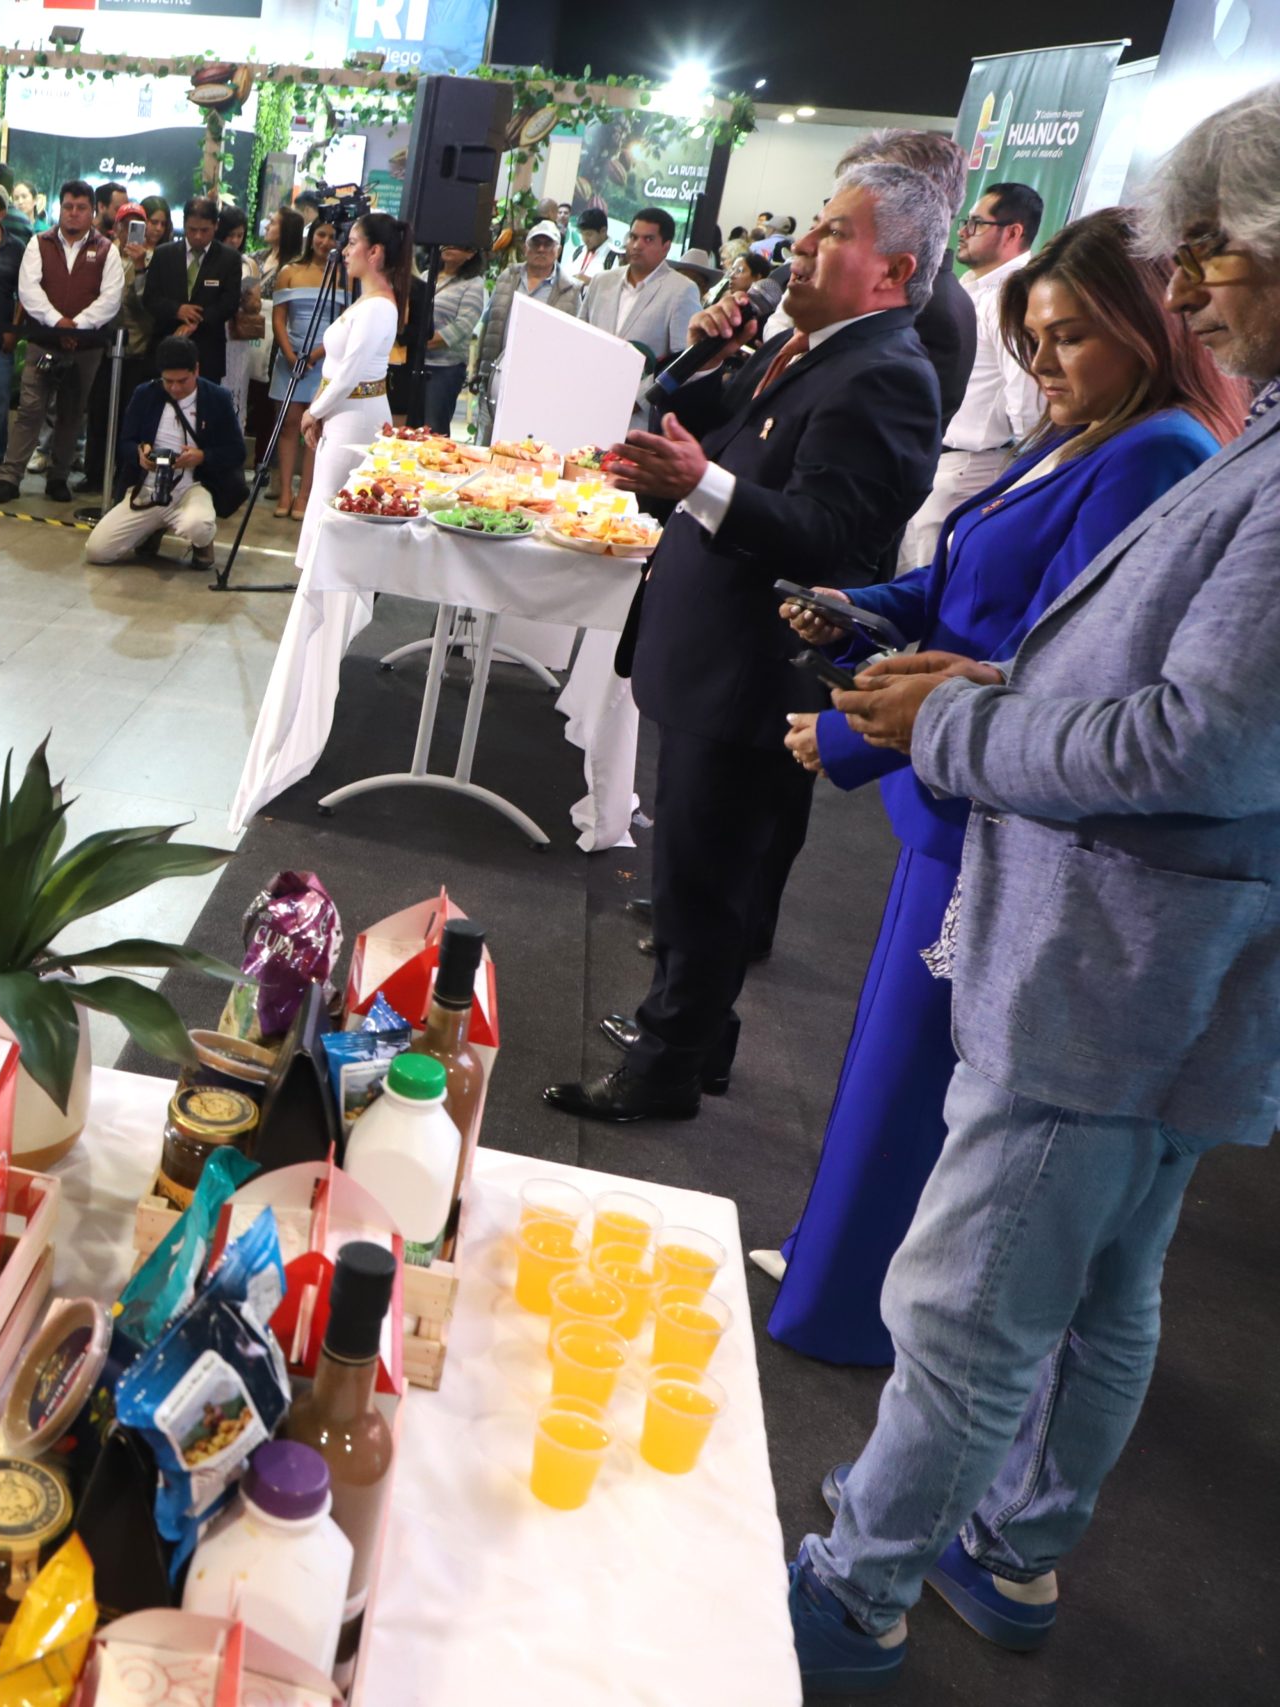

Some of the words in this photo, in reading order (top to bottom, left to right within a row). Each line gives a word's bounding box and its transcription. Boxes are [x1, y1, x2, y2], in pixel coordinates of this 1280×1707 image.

[99, 157, 115, 173] El
[115, 162, 146, 180] mejor
[668, 164, 679, 176] LA
[680, 165, 696, 177] RUTA
[643, 177, 678, 200] Cacao
[10, 1461, 41, 1480] MIEL
